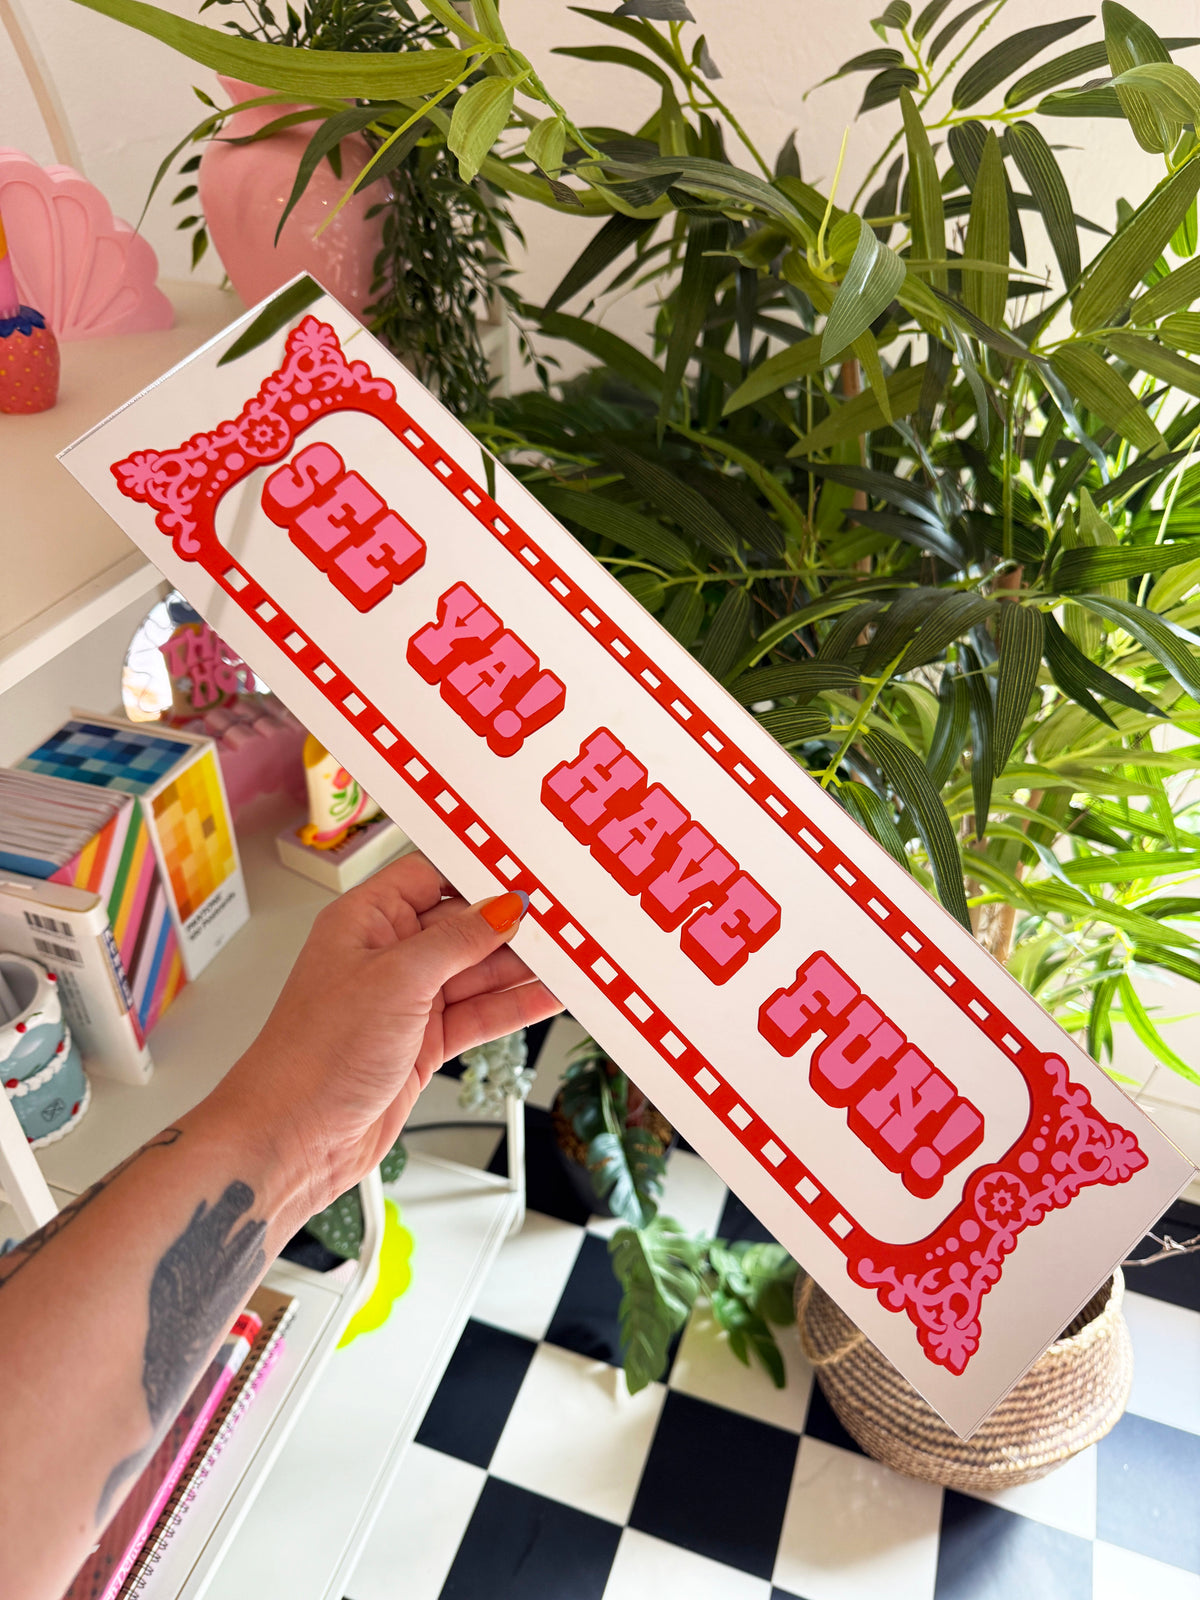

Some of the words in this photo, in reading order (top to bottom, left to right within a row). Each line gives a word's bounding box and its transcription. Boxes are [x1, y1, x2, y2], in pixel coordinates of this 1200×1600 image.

[261, 442, 427, 613] SEE
[406, 581, 567, 757] YA!
[540, 726, 782, 986] HAVE
[757, 950, 985, 1199] FUN!
